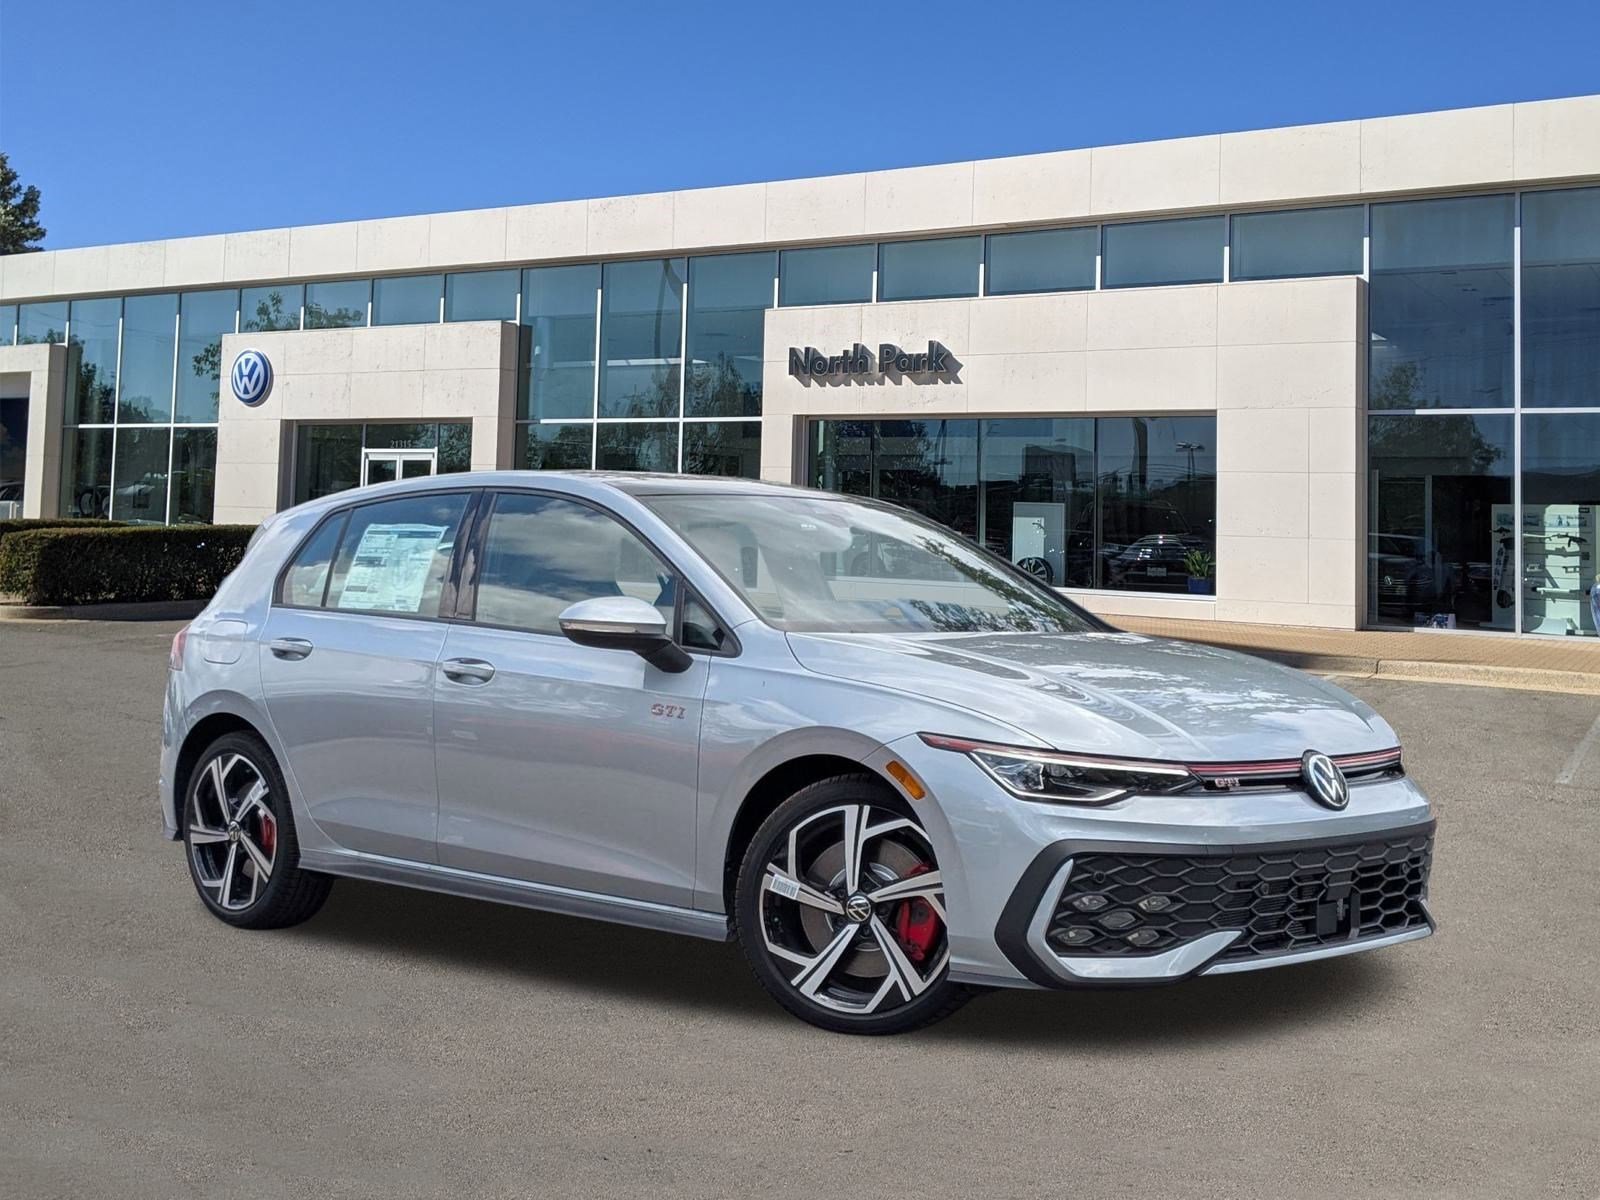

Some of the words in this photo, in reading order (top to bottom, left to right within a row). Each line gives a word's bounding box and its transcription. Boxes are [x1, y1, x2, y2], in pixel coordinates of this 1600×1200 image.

[788, 342, 872, 376] North
[878, 340, 947, 373] Park
[651, 703, 686, 720] GTI
[1214, 777, 1241, 788] GTI
